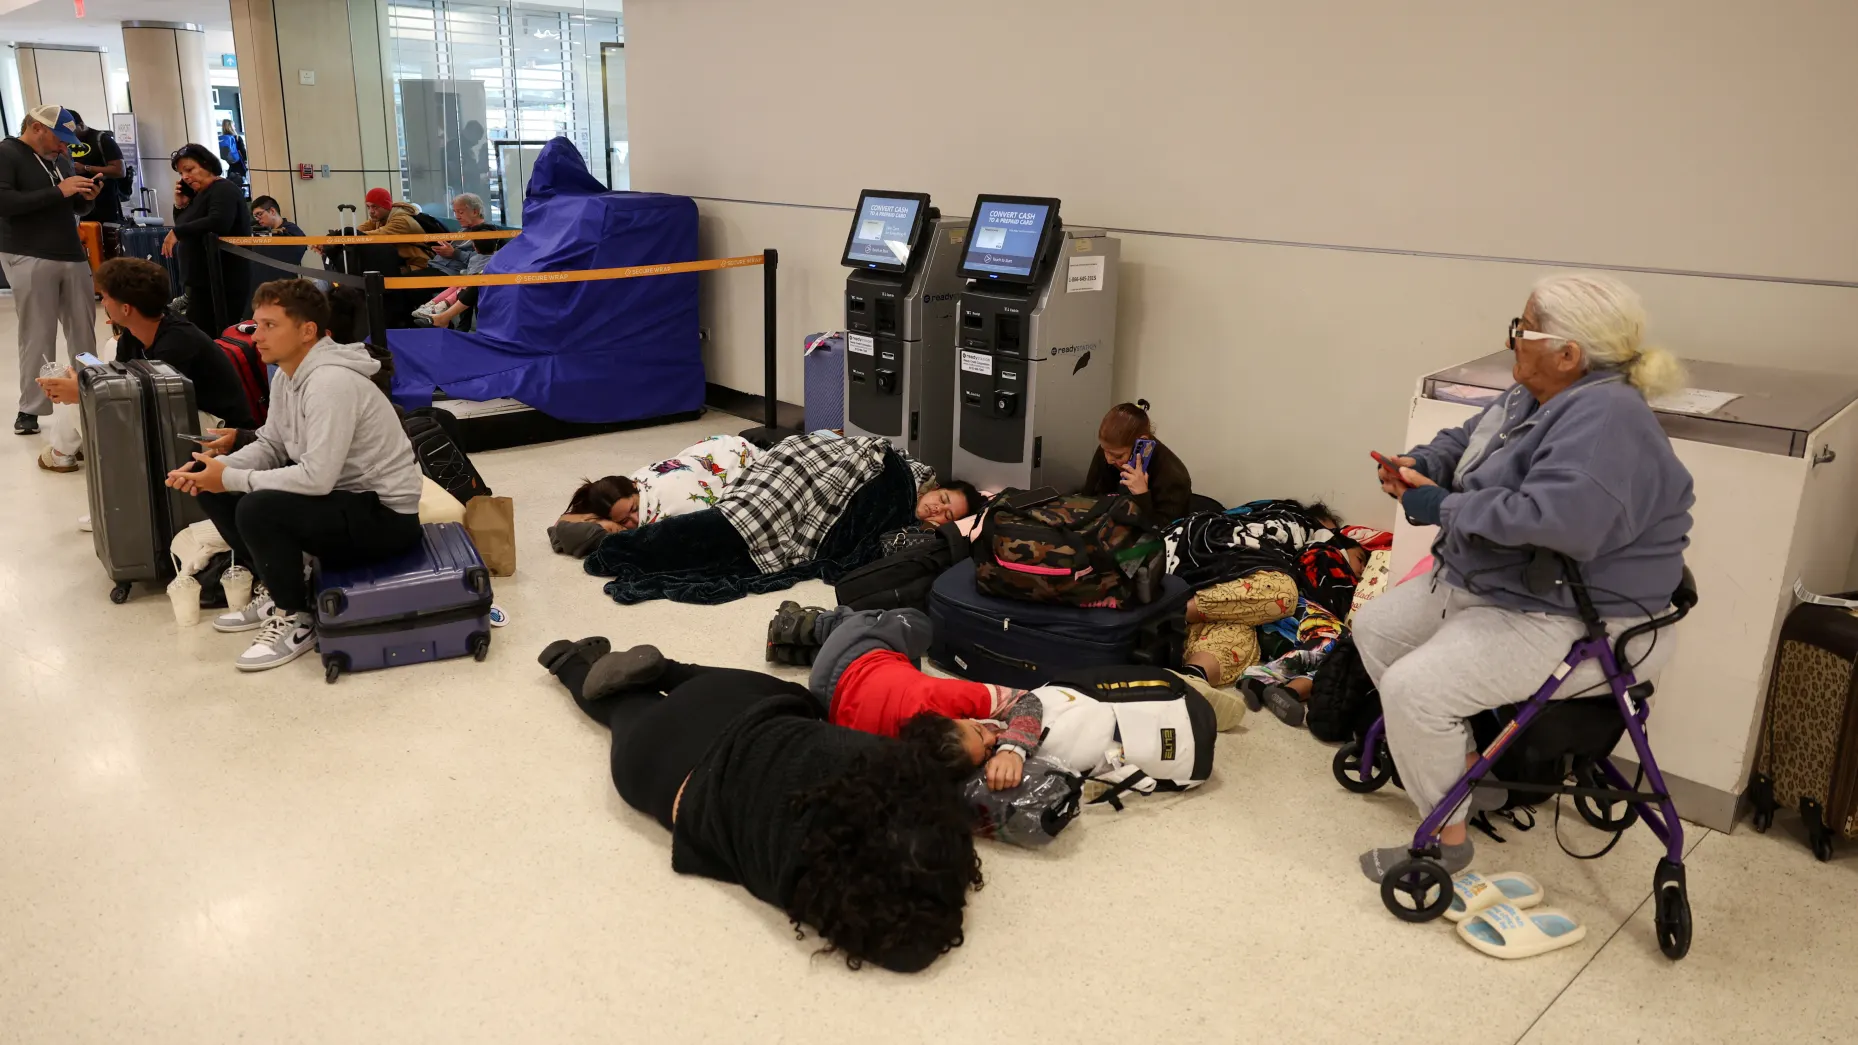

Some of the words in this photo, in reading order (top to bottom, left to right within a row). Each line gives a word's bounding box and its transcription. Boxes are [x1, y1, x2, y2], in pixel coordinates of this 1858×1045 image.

[870, 204, 895, 213] CONVERT
[894, 205, 909, 214] CASH
[989, 210, 1018, 219] CONVERT
[1018, 212, 1036, 220] CASH
[523, 274, 548, 282] SECURE
[548, 273, 569, 281] WRAP
